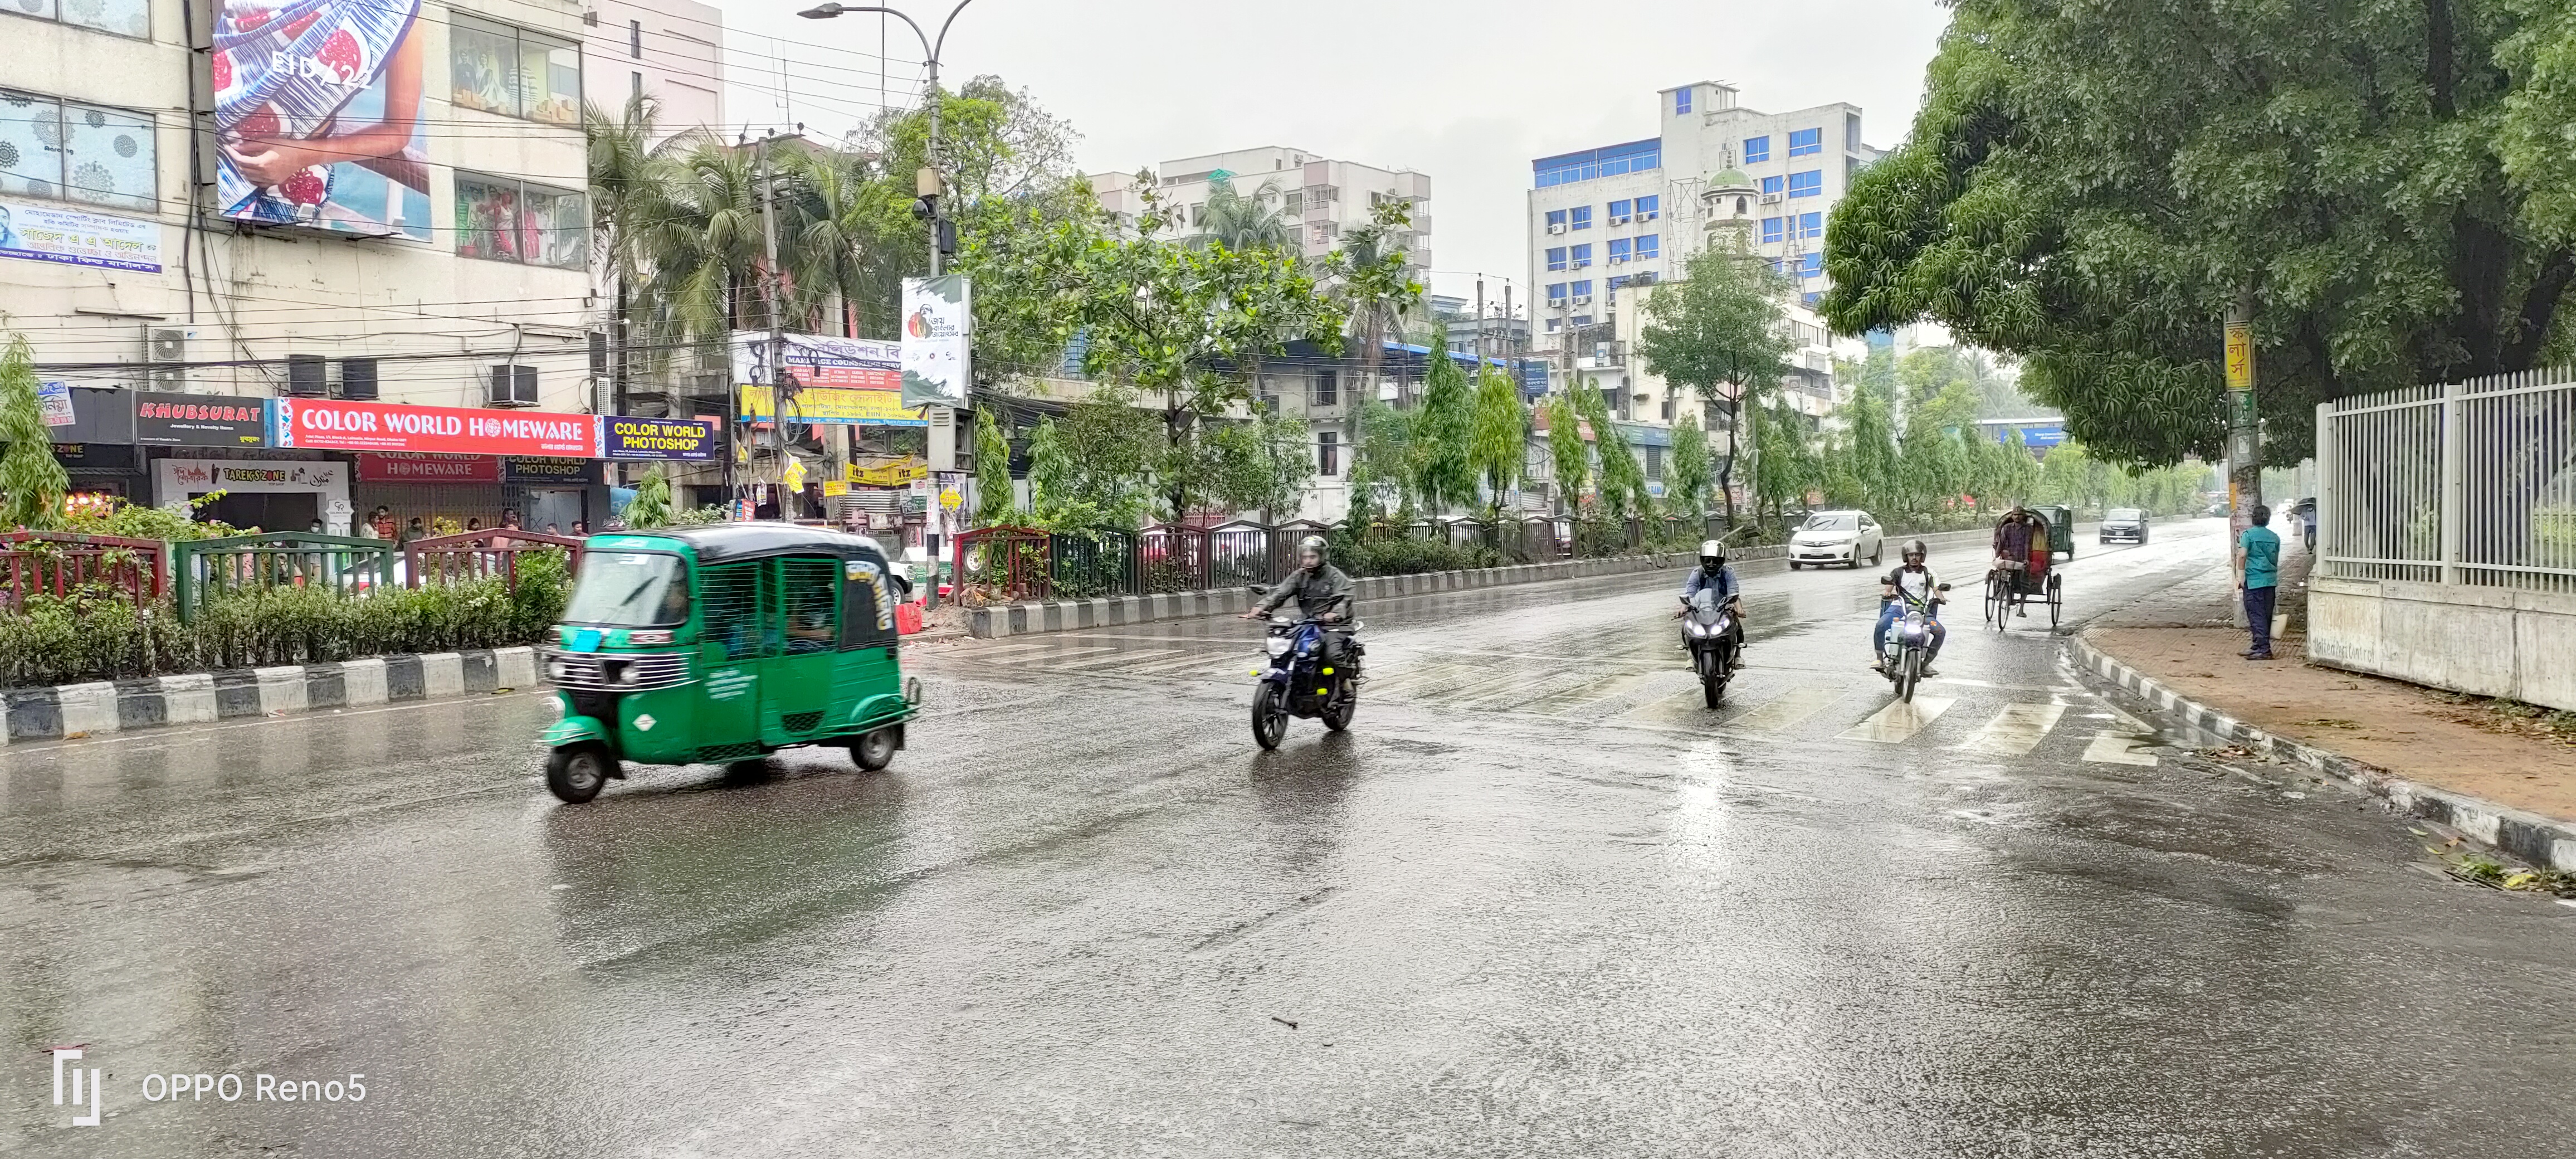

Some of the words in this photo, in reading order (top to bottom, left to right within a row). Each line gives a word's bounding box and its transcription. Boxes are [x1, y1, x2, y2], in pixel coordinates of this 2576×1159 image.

[18, 228, 65, 244] সাজেদ
[69, 235, 80, 245] এ
[85, 236, 97, 247] এ
[100, 238, 144, 253] আদেল
[47, 254, 73, 262] ঢাকা
[931, 317, 945, 326] জয়
[140, 402, 261, 422] KHUBSURAT
[302, 409, 378, 432] COLOR
[383, 413, 461, 436] WORLD
[469, 417, 583, 441] HOMEWARE
[614, 422, 658, 436] COLOR
[661, 425, 706, 439] WORLD
[623, 437, 699, 451] PHOTOSHOP
[387, 462, 472, 475] HOMEWARE
[515, 465, 581, 475] PHOTOSHOP
[853, 466, 864, 478] itz
[898, 469, 911, 478] itz
